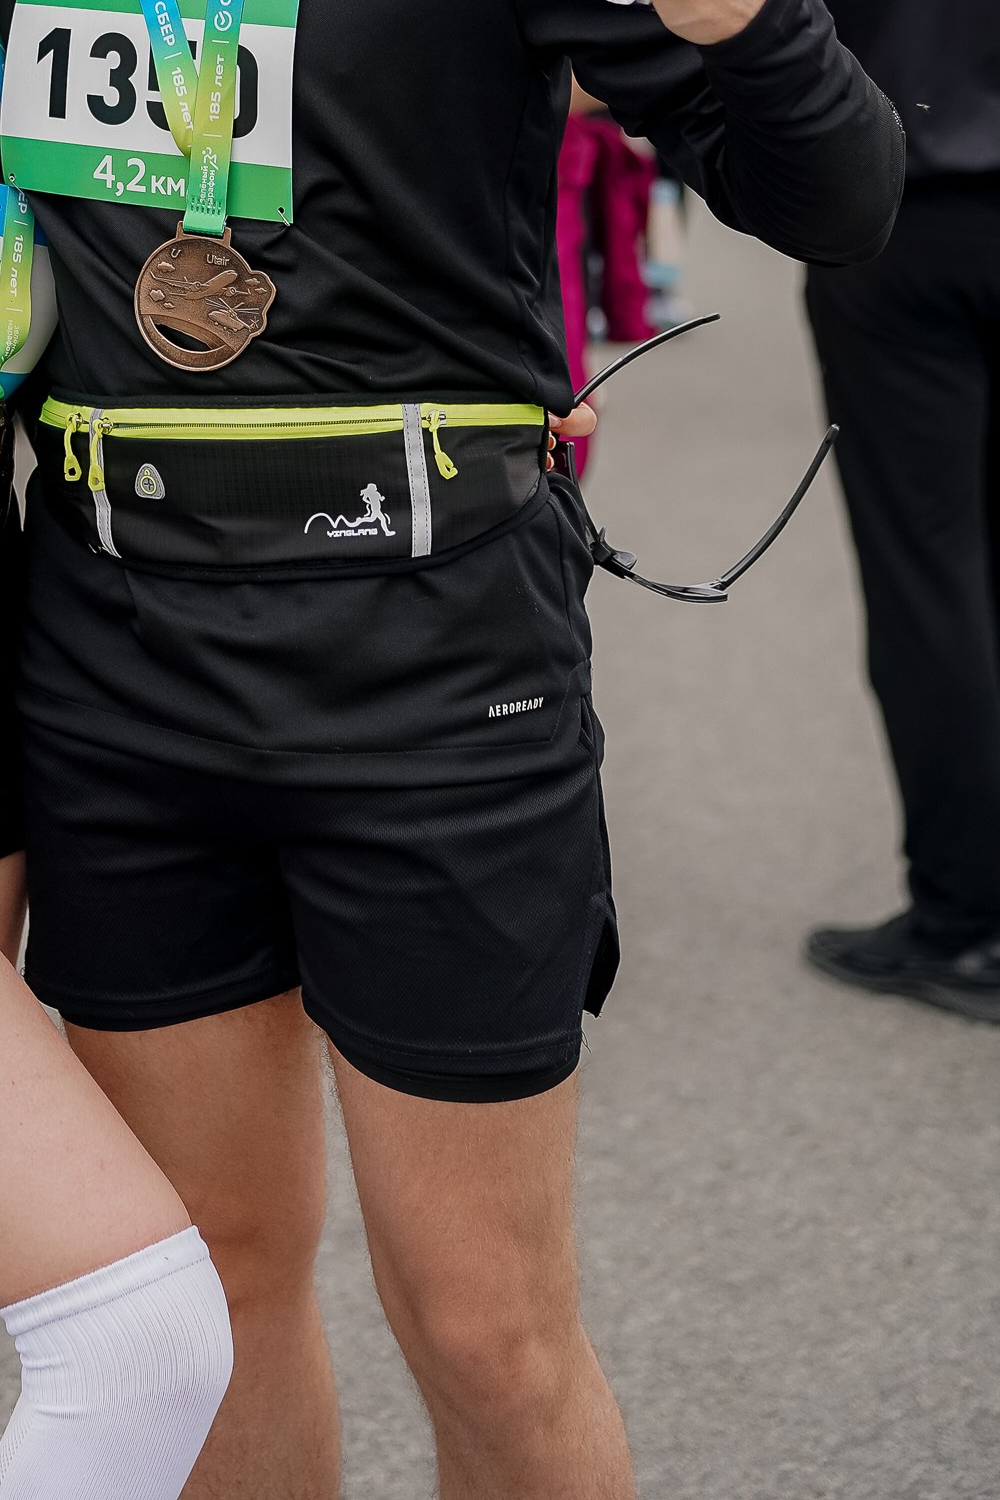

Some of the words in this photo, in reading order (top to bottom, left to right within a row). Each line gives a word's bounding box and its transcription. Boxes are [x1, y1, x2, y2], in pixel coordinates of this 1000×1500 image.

[154, 0, 176, 47] СБЕР
[171, 66, 188, 99] 185
[214, 54, 225, 87] лет
[179, 100, 194, 131] лет
[209, 91, 221, 122] 185
[12, 234, 24, 264] 185
[206, 253, 231, 267] Utair
[9, 267, 18, 298] лет
[488, 696, 544, 718] AEROREADY
